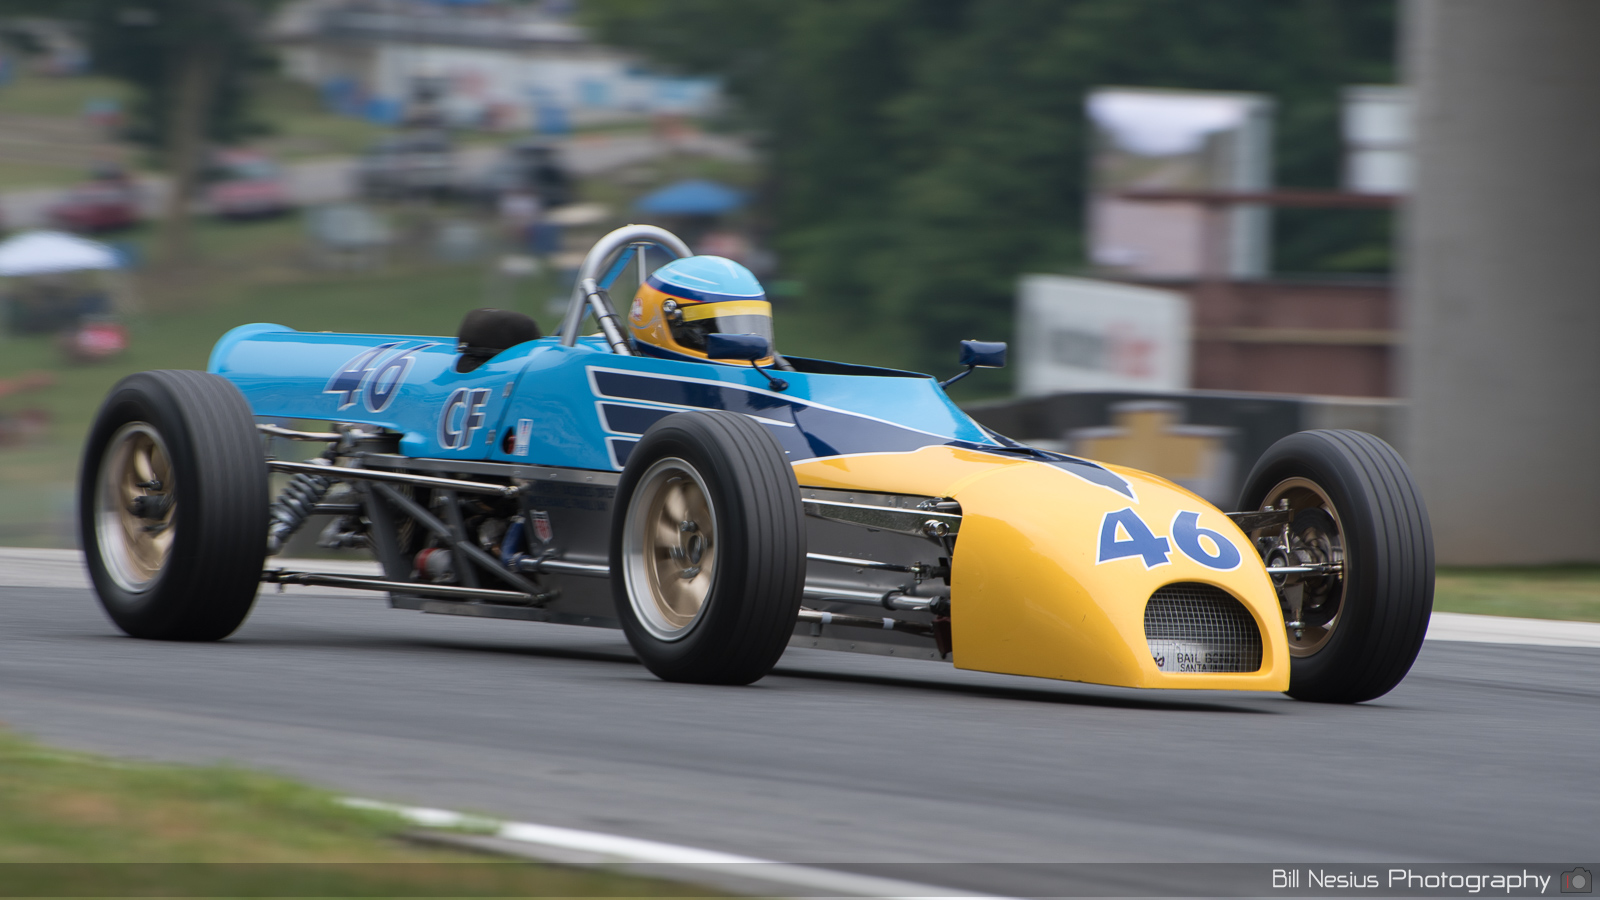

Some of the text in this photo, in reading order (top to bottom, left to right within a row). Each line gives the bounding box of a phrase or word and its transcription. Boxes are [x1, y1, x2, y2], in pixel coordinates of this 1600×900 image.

[322, 341, 441, 413] 46
[437, 387, 492, 450] CF
[1095, 506, 1243, 572] 46
[1177, 653, 1201, 664] BAIL
